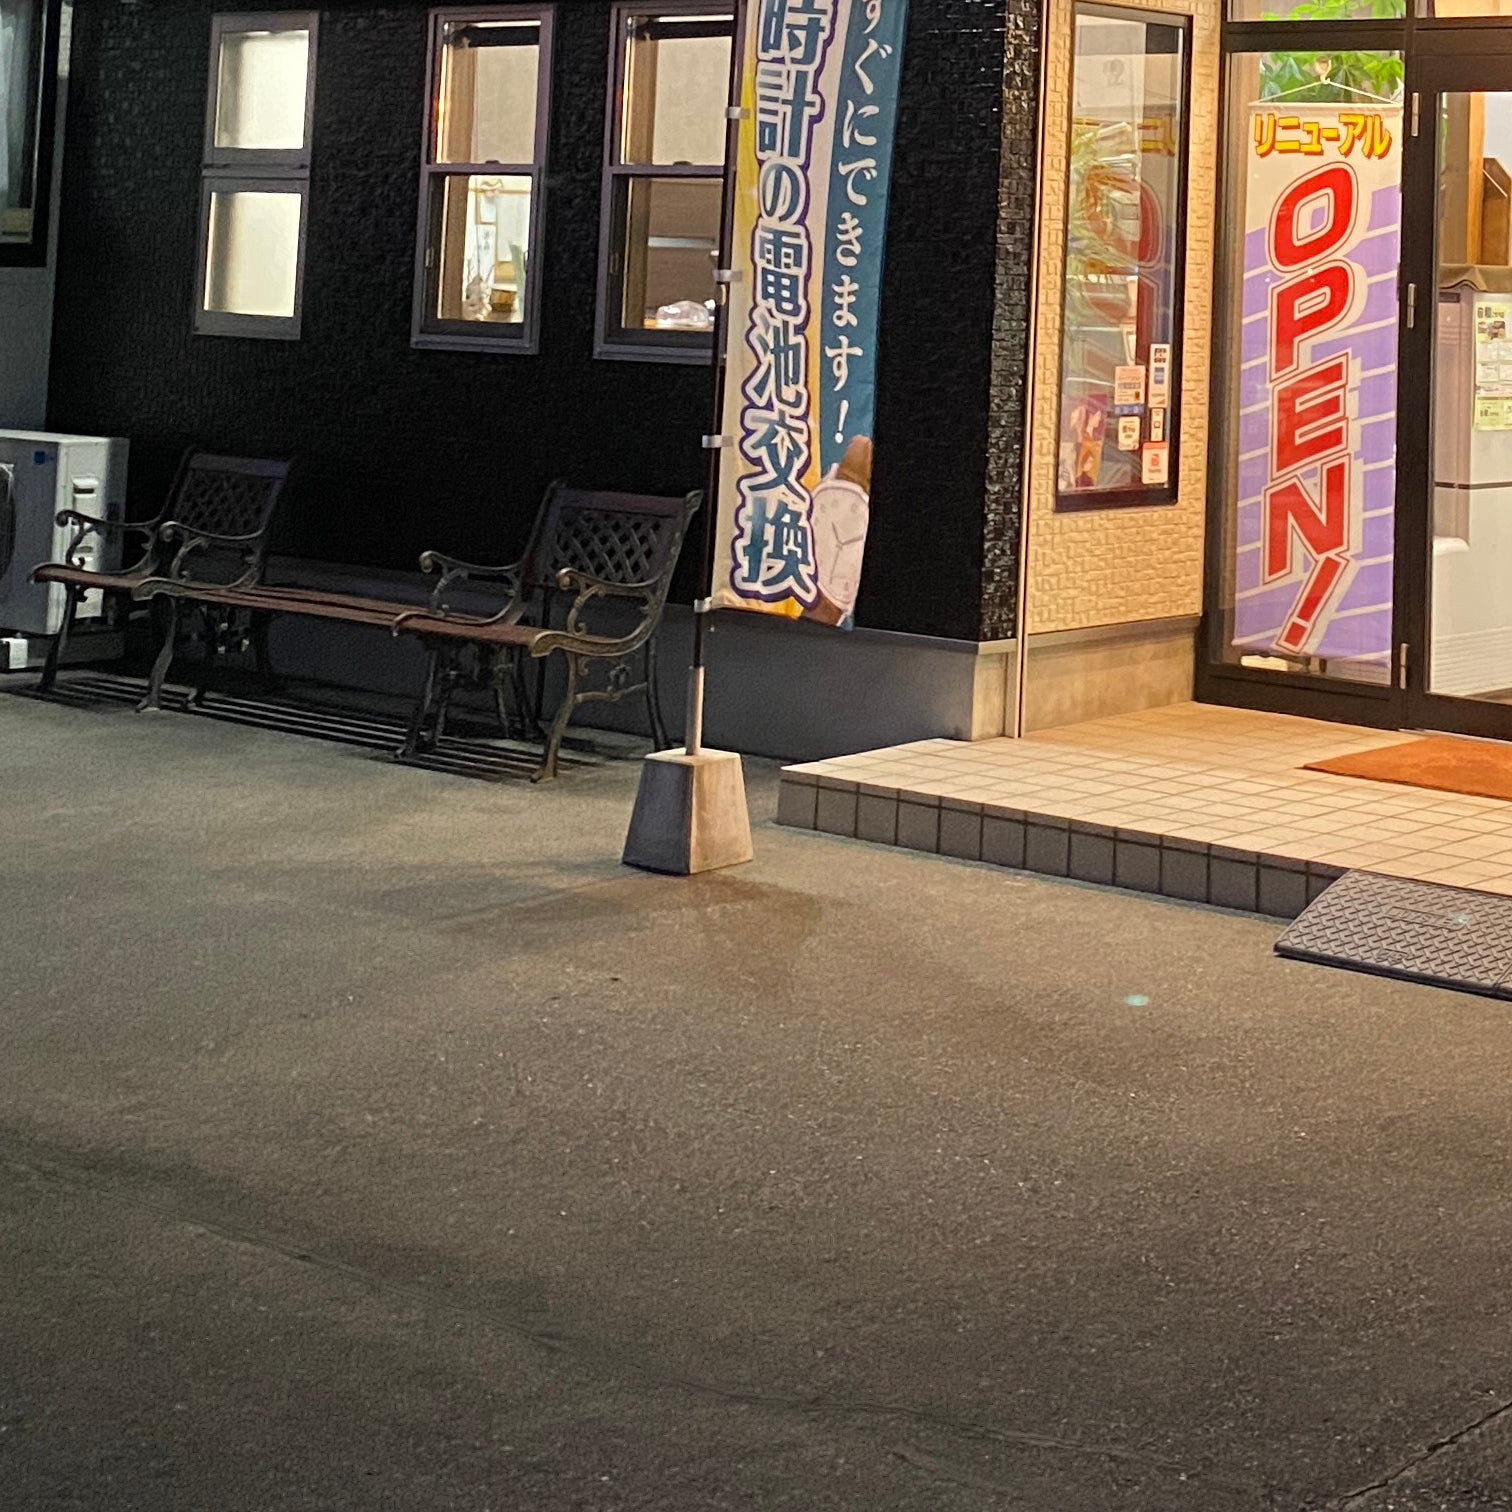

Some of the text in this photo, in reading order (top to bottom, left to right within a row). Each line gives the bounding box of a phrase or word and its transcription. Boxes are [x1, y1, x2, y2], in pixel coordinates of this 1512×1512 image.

[1253, 113, 1392, 159] リニューアル
